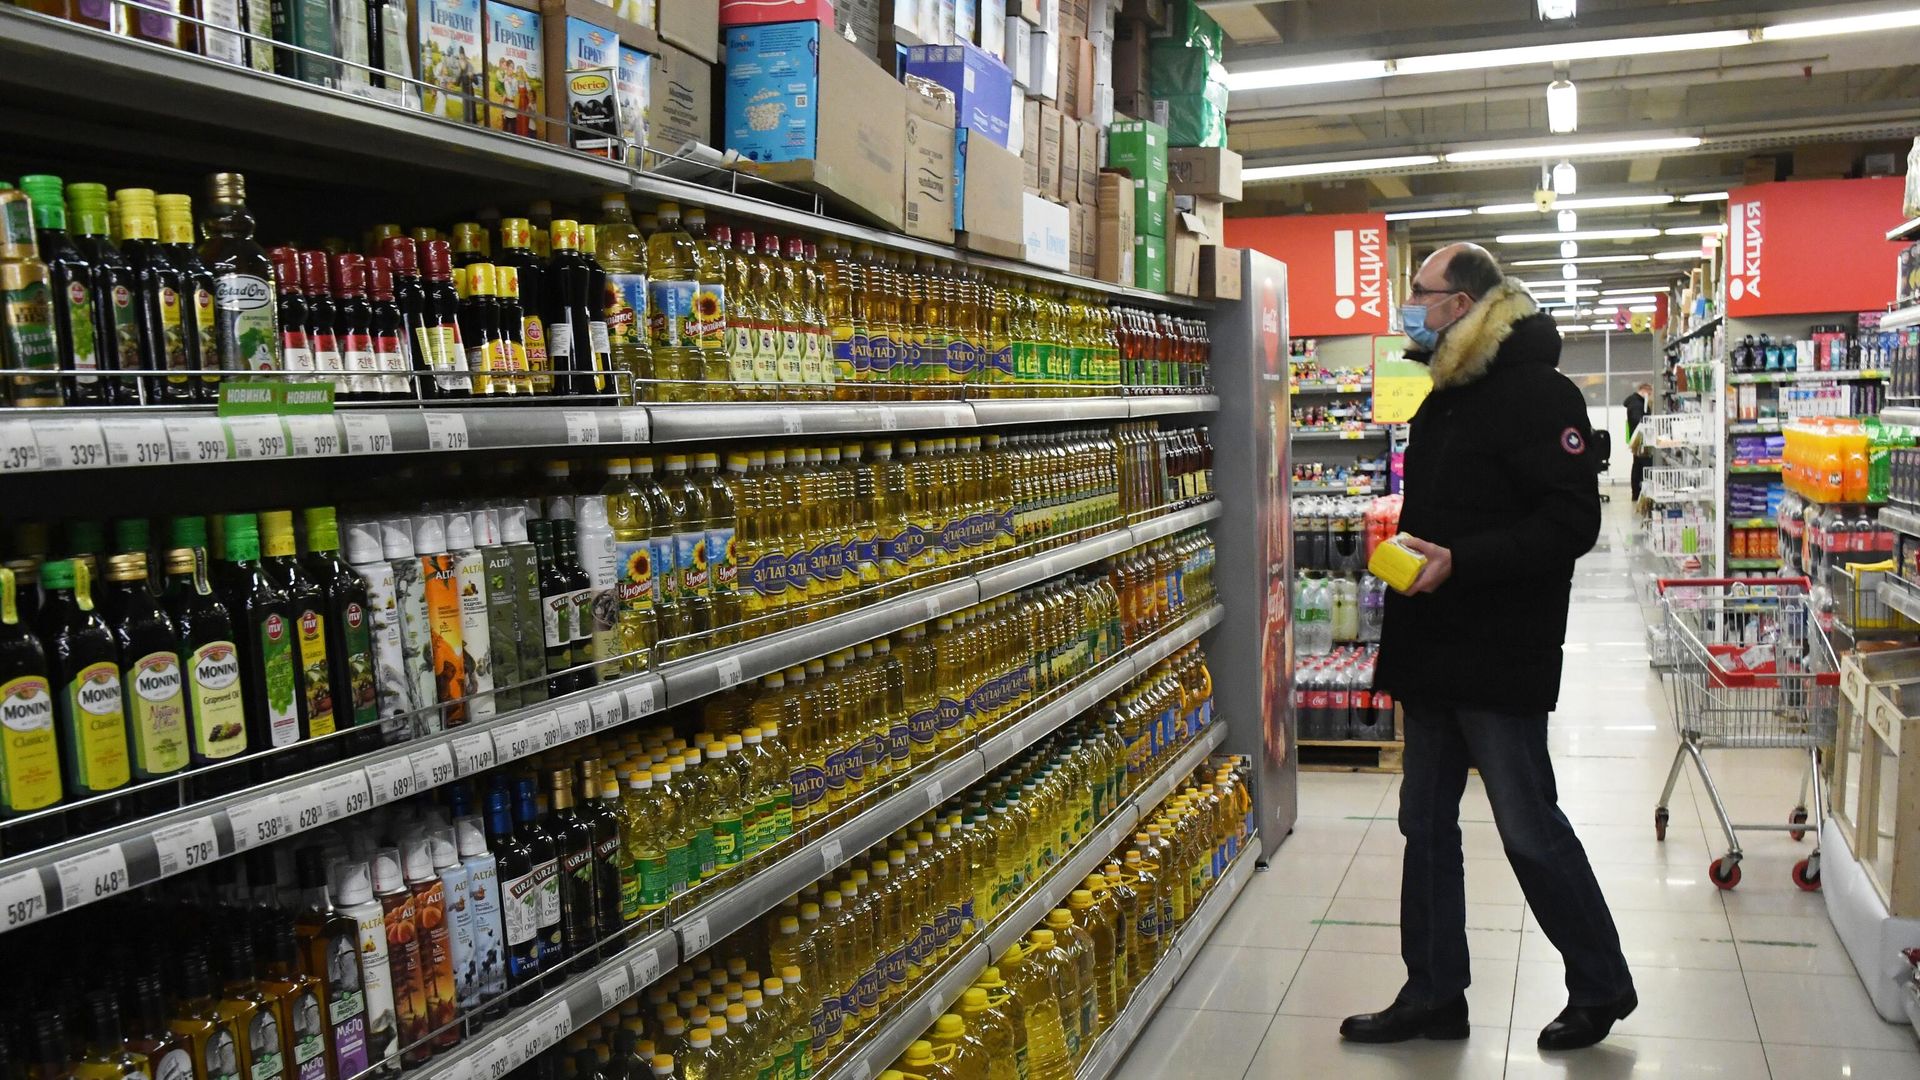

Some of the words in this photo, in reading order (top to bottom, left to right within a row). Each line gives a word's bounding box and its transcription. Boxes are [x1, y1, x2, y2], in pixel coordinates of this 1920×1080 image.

[573, 80, 606, 91] Iberica
[1746, 201, 1764, 298] АКЦИЯ
[1359, 228, 1384, 318] АКЦИЯ
[227, 389, 273, 403] НОВИНКА
[287, 390, 329, 404] НОВИНКА
[199, 662, 237, 680] MONINI
[140, 673, 180, 691] MONINI
